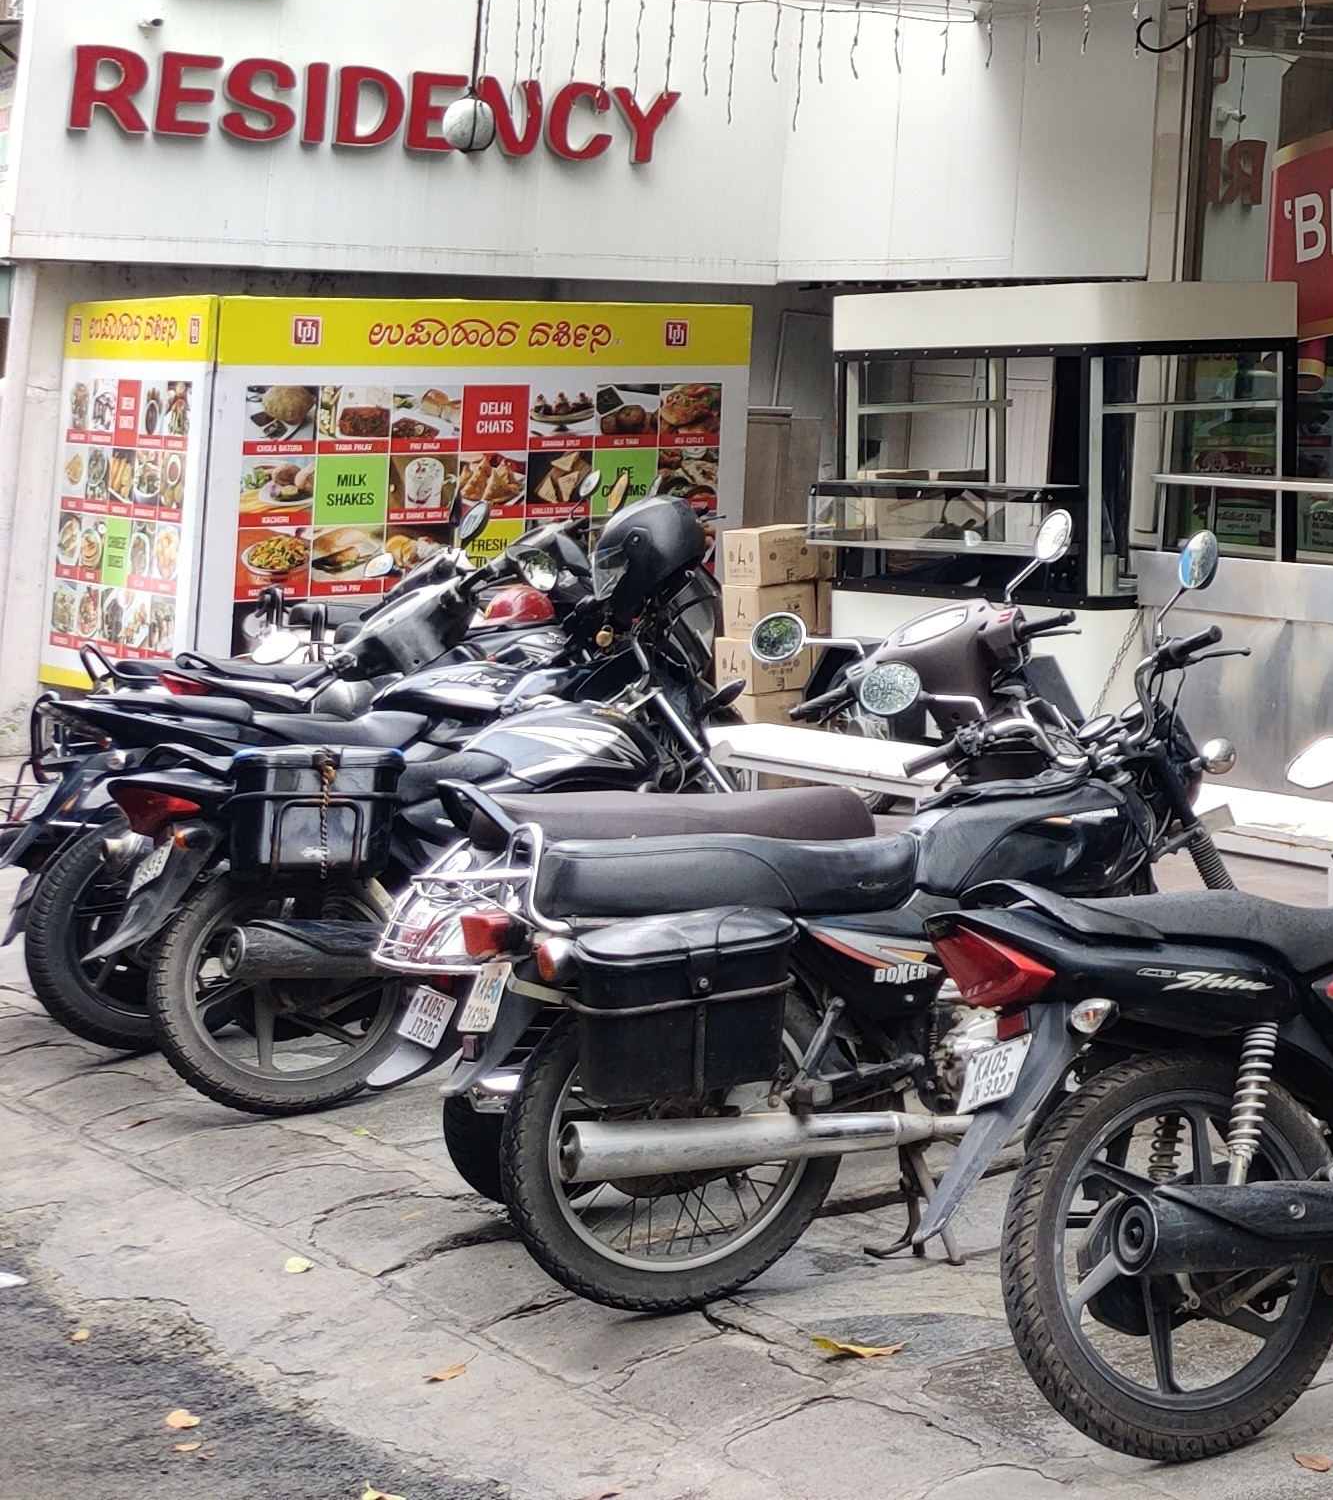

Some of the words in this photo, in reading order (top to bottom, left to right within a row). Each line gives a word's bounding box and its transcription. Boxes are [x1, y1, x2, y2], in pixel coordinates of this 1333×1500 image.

[67, 43, 682, 165] RESIDENCY
[479, 401, 512, 417] DELHI
[476, 418, 514, 434] CHATS
[337, 473, 367, 488] MILK
[326, 492, 375, 508] SHAKES
[471, 538, 508, 553] FRESH
[873, 963, 928, 985] BOXER
[1161, 971, 1275, 992] Shine
[973, 1046, 1015, 1083] KA05
